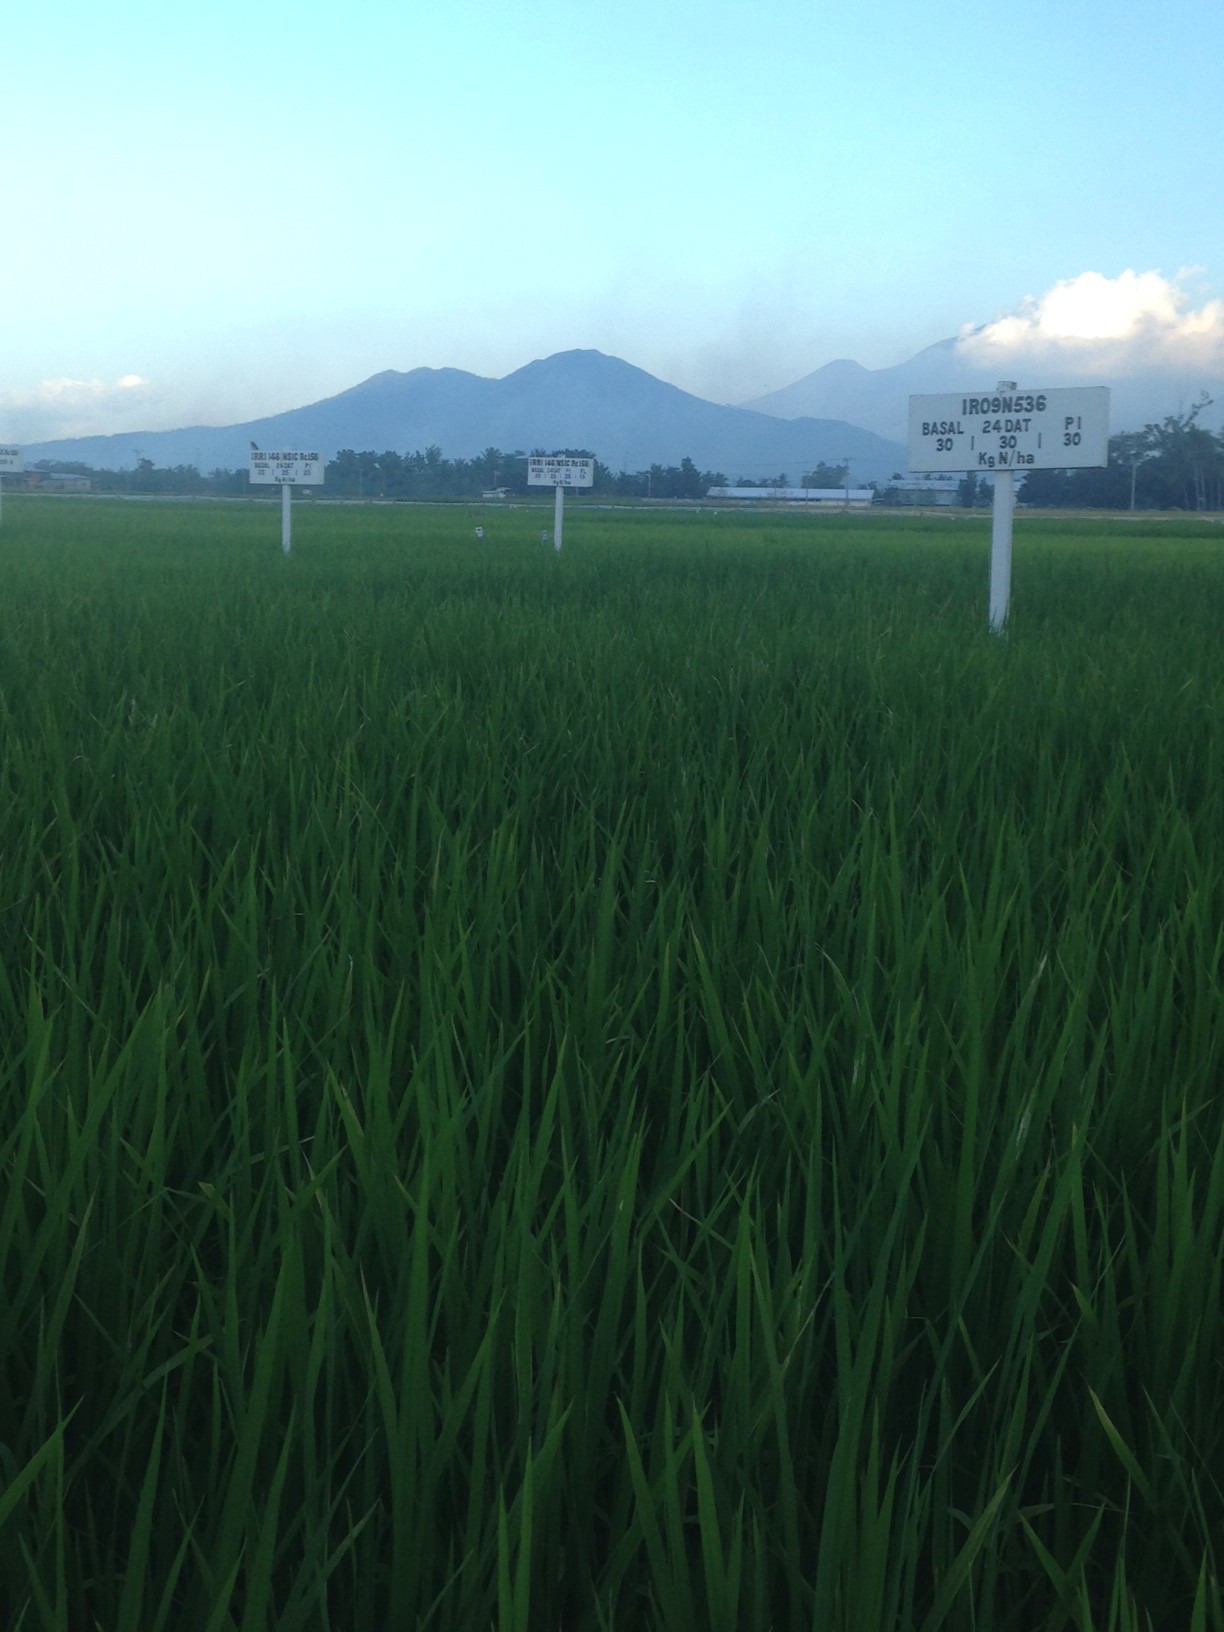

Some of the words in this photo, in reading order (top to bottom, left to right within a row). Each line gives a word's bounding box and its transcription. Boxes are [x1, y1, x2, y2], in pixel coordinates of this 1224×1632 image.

[922, 422, 964, 435] BASAL
[936, 438, 953, 451] 30
[999, 436, 1017, 449] 30
[1063, 433, 1081, 446] 30
